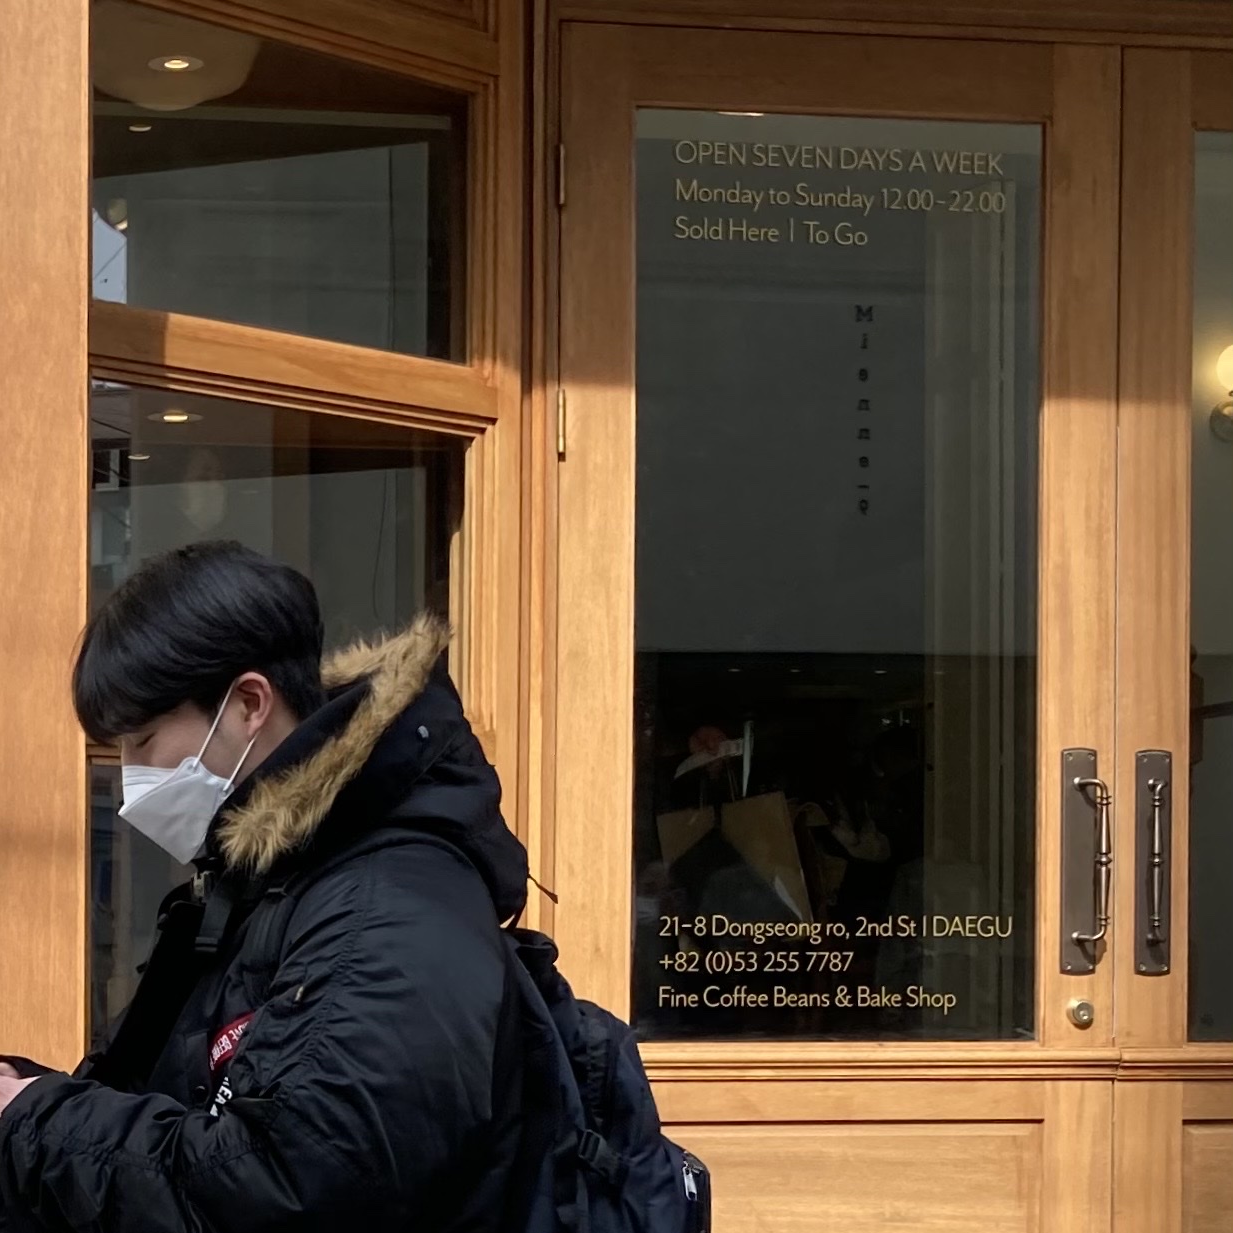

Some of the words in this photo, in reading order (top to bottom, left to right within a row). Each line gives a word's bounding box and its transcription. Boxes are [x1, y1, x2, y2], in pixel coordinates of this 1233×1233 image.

[675, 140, 747, 165] OPEN
[752, 143, 833, 169] SEVEN
[839, 147, 903, 172] DAYS
[908, 151, 927, 173] A
[932, 151, 1004, 176] WEEK
[675, 178, 764, 213] Monday
[768, 188, 791, 206] to
[795, 183, 874, 217] Sunday
[674, 215, 723, 241] Sold
[728, 217, 780, 243] Here
[803, 221, 829, 245] To
[834, 221, 868, 246] Go
[659, 915, 707, 937] 21-8
[712, 915, 822, 944] Dongseong
[825, 919, 851, 940] ro,
[855, 915, 893, 938] 2nd
[897, 915, 917, 938] St
[932, 916, 1013, 938] DAEGU
[659, 952, 700, 972] +82
[705, 951, 758, 974] (0)53
[763, 952, 800, 972] 255
[805, 952, 854, 972] 7787
[658, 986, 699, 1008] Fine
[703, 986, 769, 1008] Coffee
[773, 986, 830, 1008] Beans
[834, 986, 854, 1008] &
[857, 986, 903, 1008] Bake
[906, 986, 957, 1015] Shop
